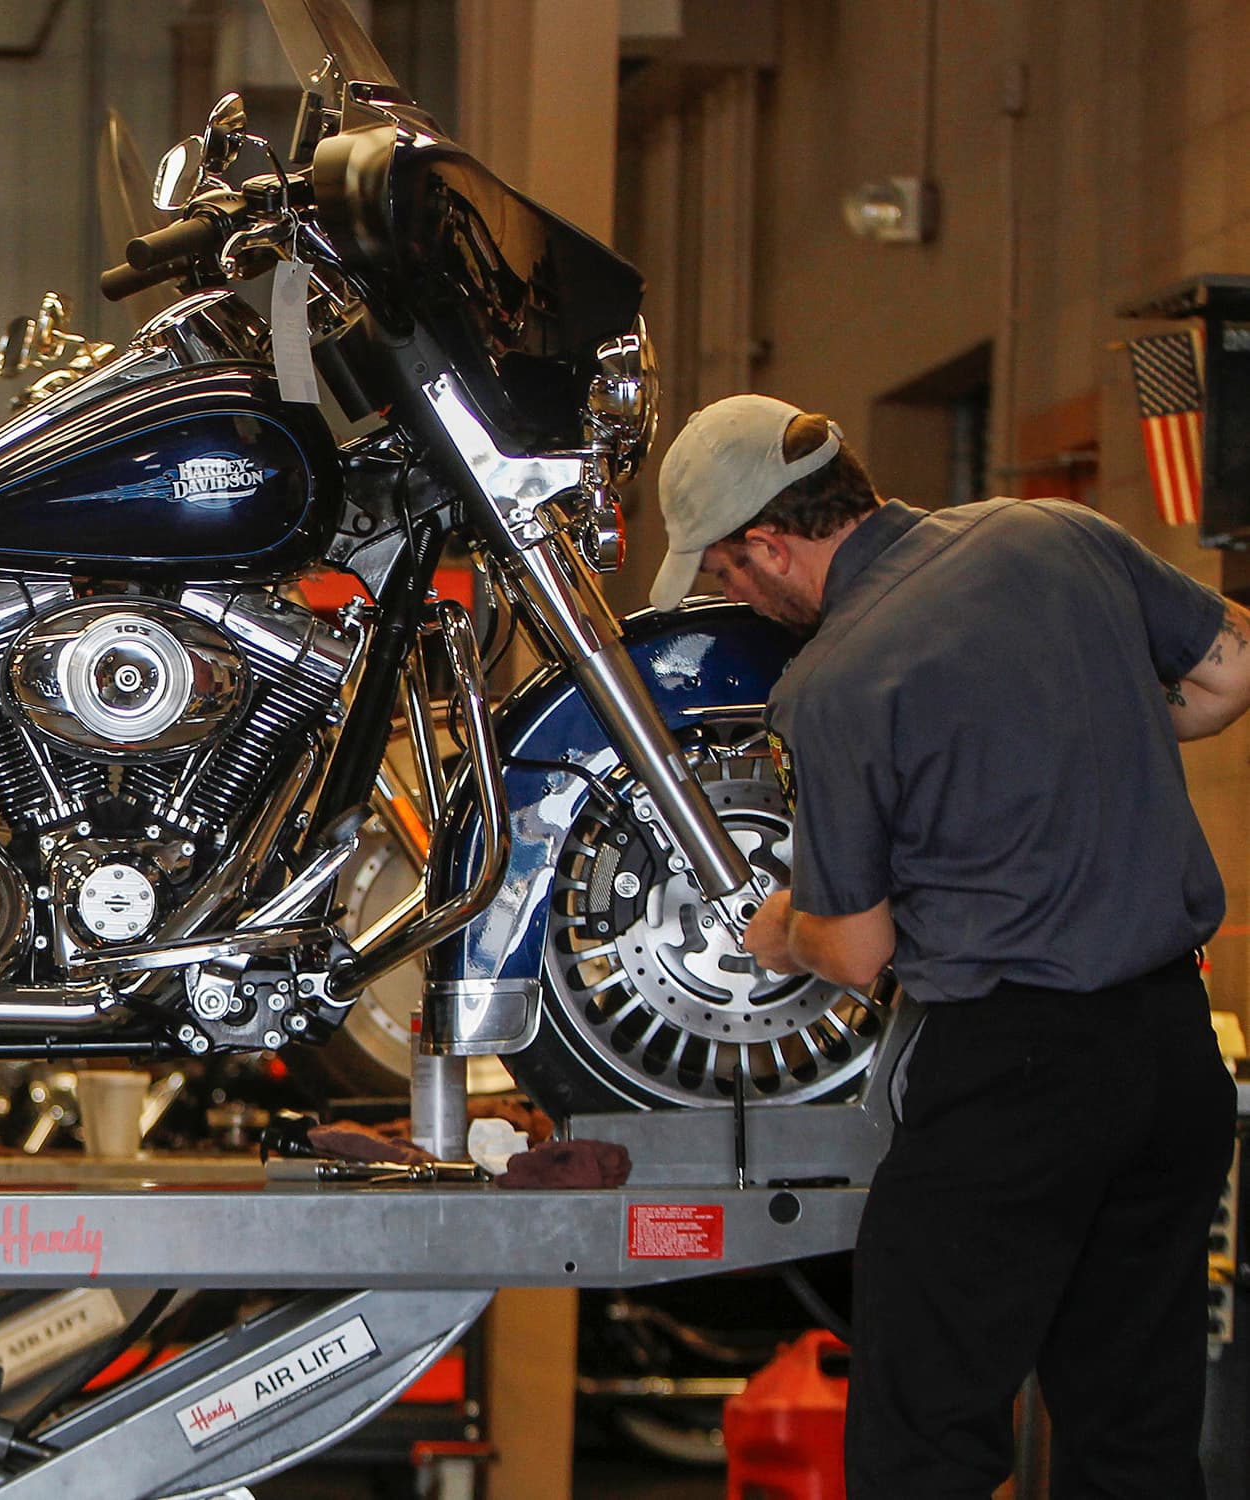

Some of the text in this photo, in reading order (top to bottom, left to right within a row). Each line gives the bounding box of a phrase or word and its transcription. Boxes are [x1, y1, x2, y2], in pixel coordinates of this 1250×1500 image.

[172, 470, 263, 499] DAVIDSON
[114, 624, 151, 636] 103
[189, 1335, 349, 1431] Handy AIR LIFT
